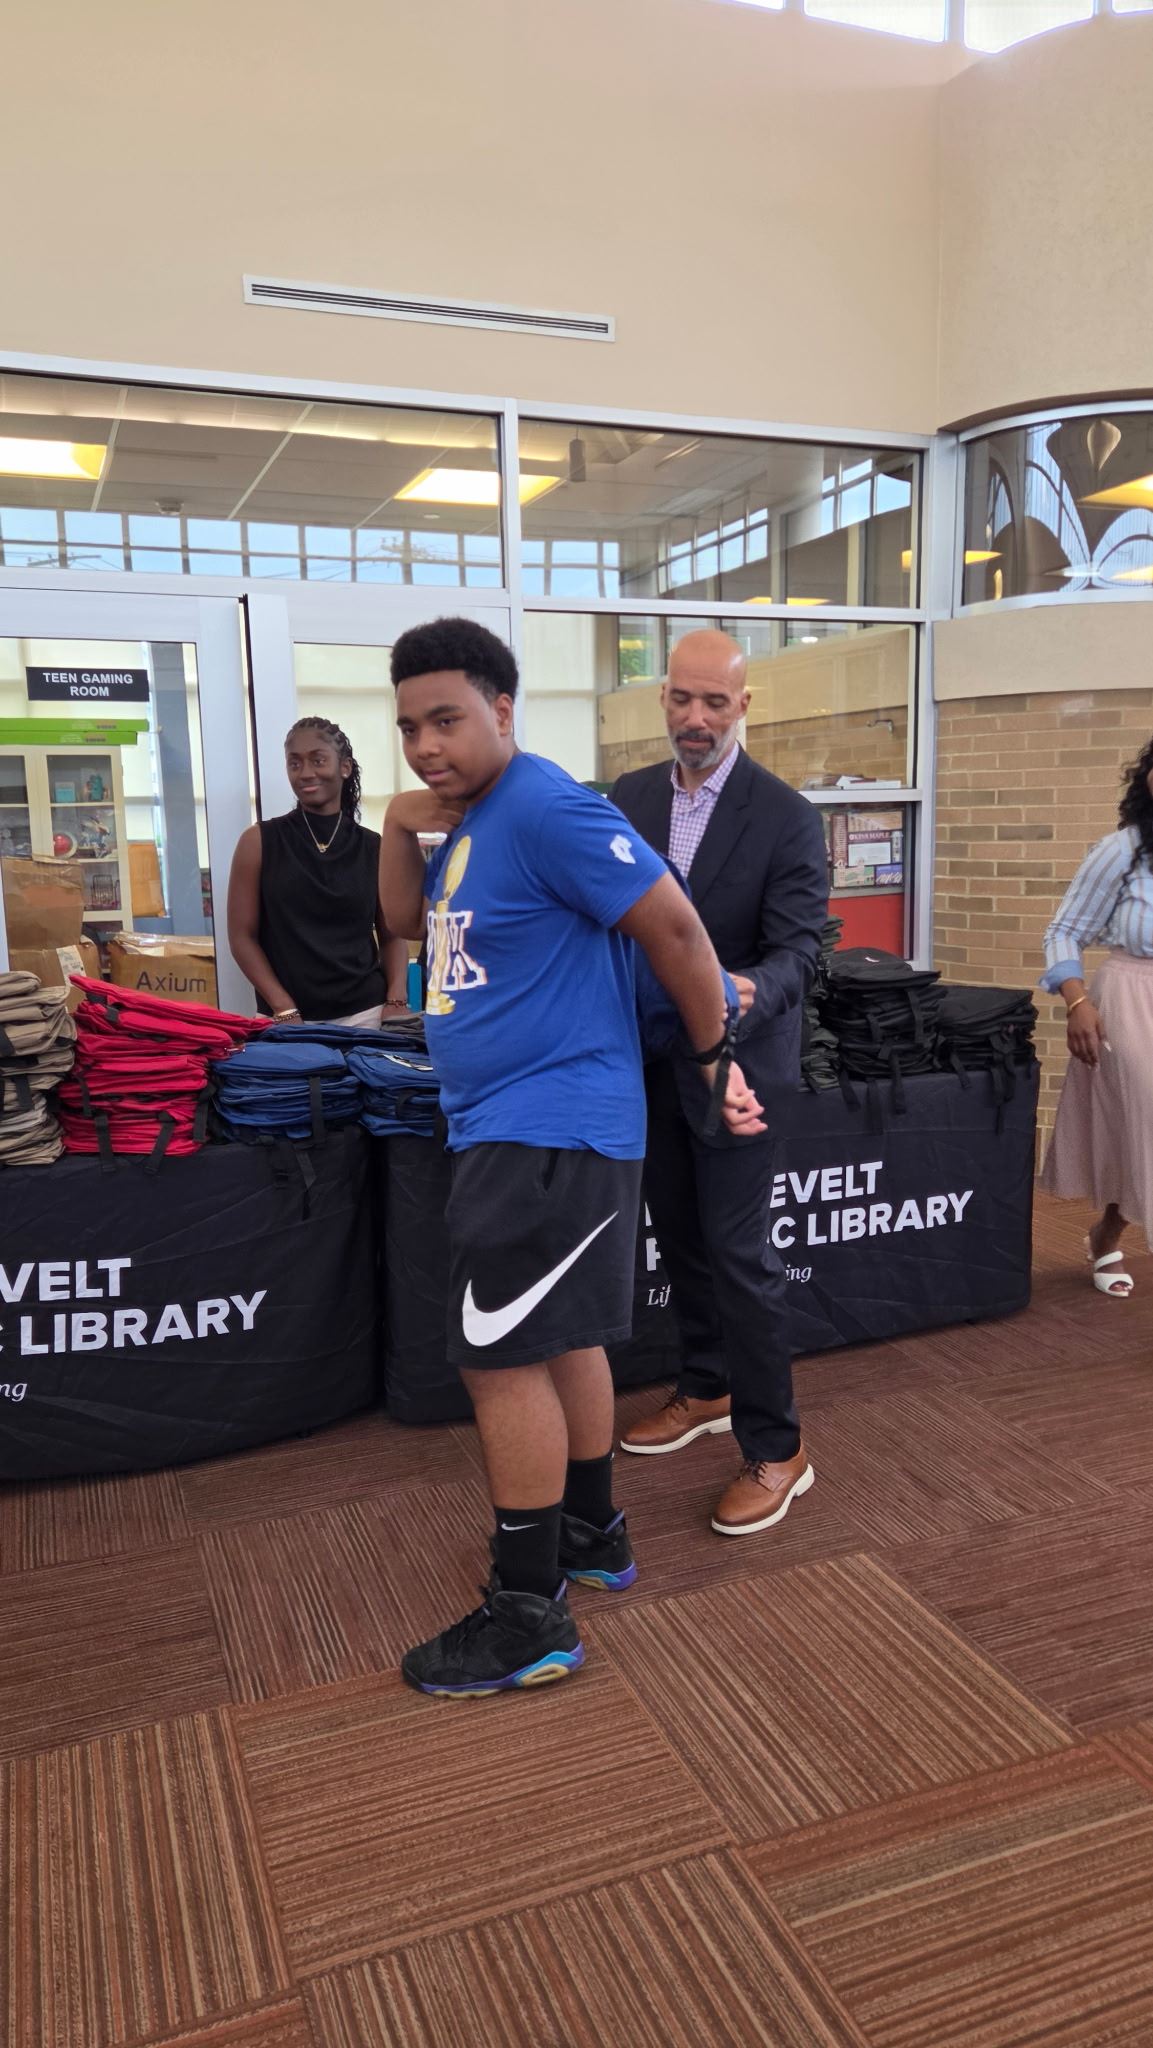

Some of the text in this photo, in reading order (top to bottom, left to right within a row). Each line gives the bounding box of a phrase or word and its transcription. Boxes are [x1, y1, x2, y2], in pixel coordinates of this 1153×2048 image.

[43, 673, 133, 684] TEEN GAMING
[70, 686, 109, 696] ROOM
[136, 971, 207, 993] Axium
[807, 1190, 974, 1246] LIBRARY
[0, 1257, 131, 1303] VELT
[20, 1290, 268, 1355] LIBRARY
